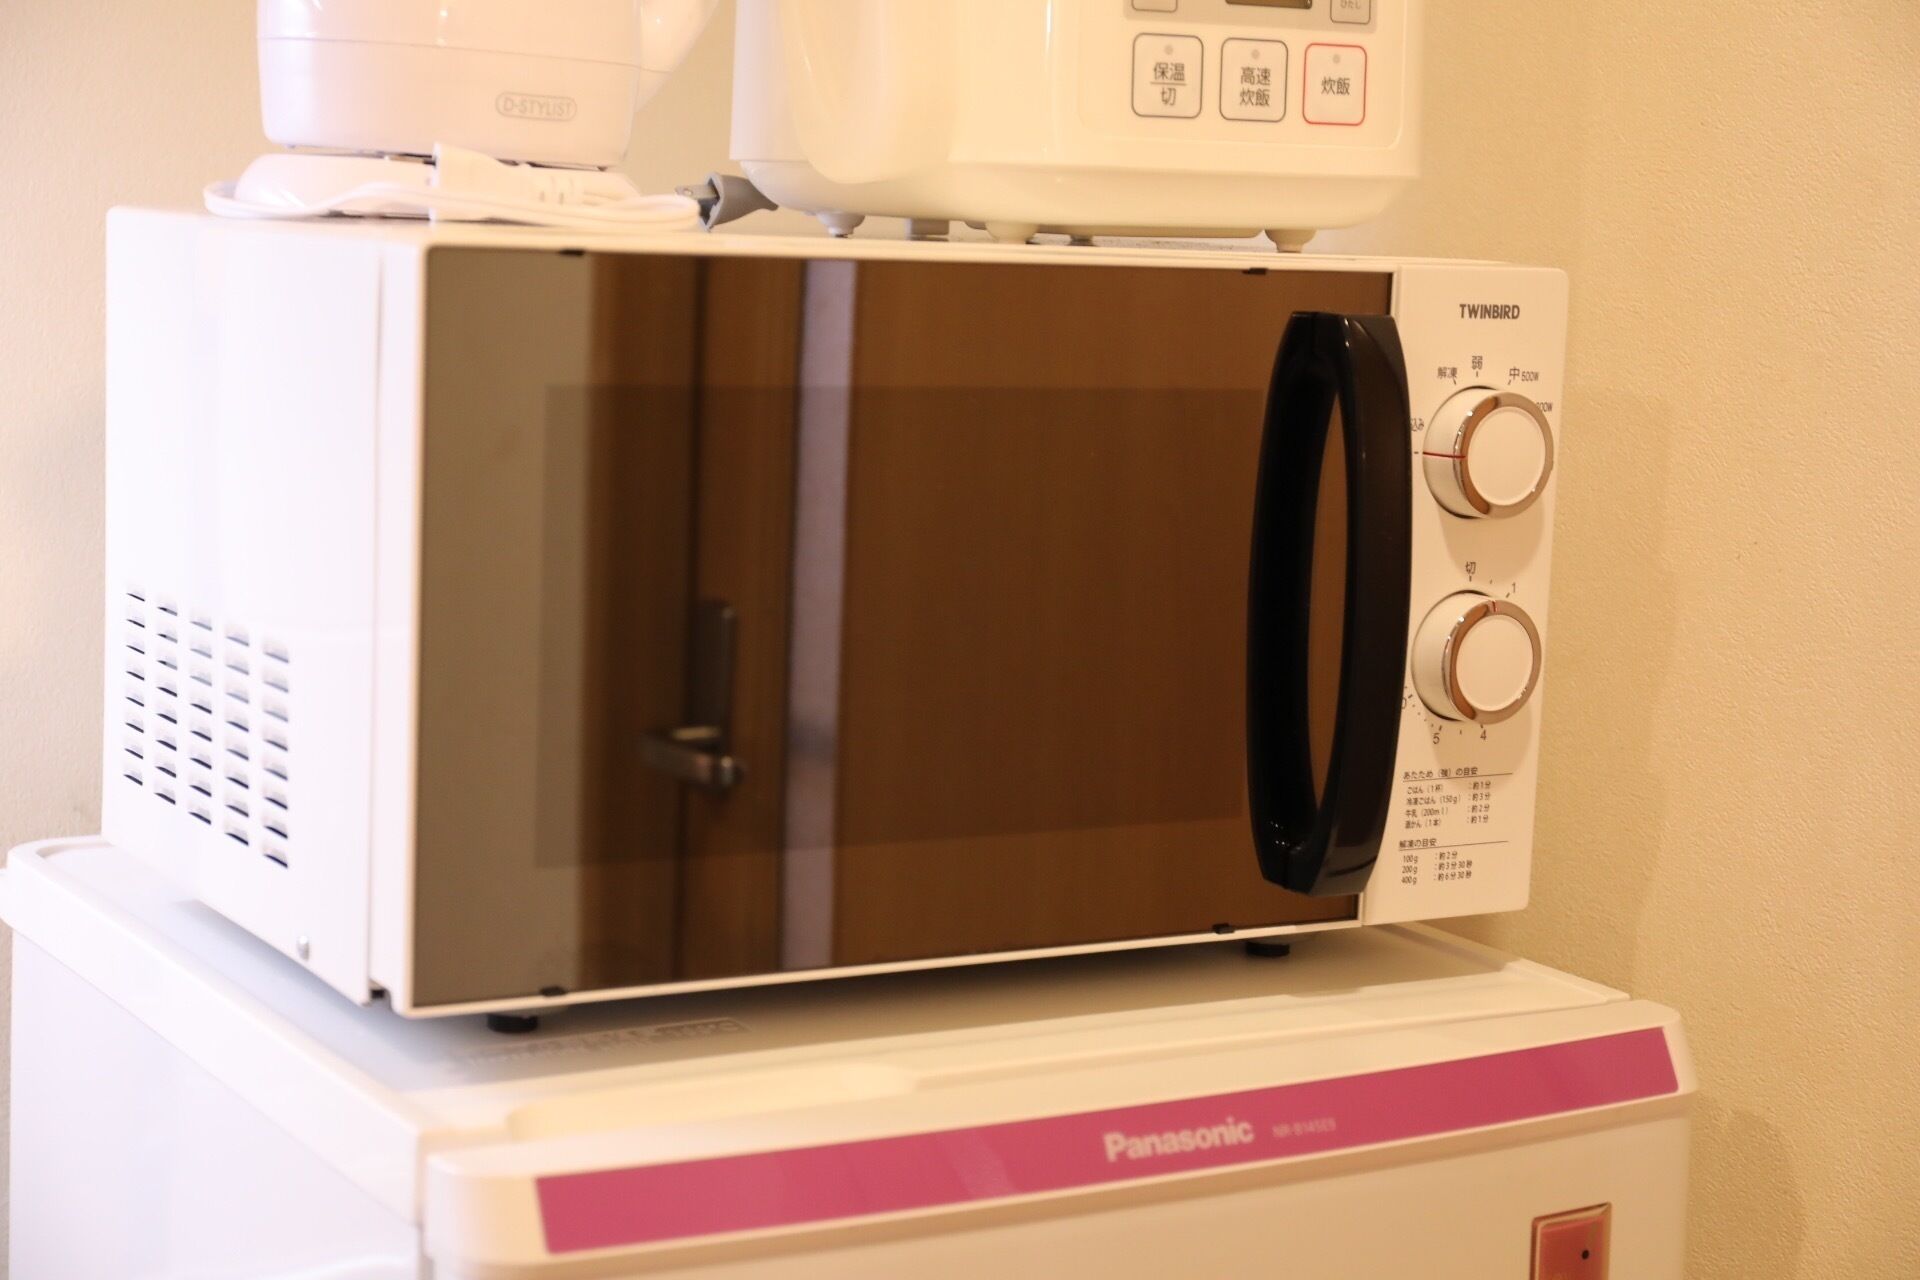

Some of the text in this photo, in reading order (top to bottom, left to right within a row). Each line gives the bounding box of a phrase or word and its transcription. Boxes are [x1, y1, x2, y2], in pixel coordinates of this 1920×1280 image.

[1153, 62, 1186, 82] 保温
[1240, 66, 1271, 86] 高速
[1321, 76, 1350, 96] 炊飯
[1161, 87, 1176, 106] 切
[1239, 88, 1270, 107] 炊飯
[503, 97, 572, 117] D-STYLIST
[1459, 304, 1520, 320] TWINBIRD
[1471, 355, 1483, 370] 弱
[1437, 366, 1458, 379] 解凍
[1509, 366, 1539, 382] 中 500W
[1465, 561, 1477, 575] 切
[1433, 733, 1440, 745] 5
[1480, 729, 1487, 741] 4
[1103, 1116, 1255, 1163] Panasonic
